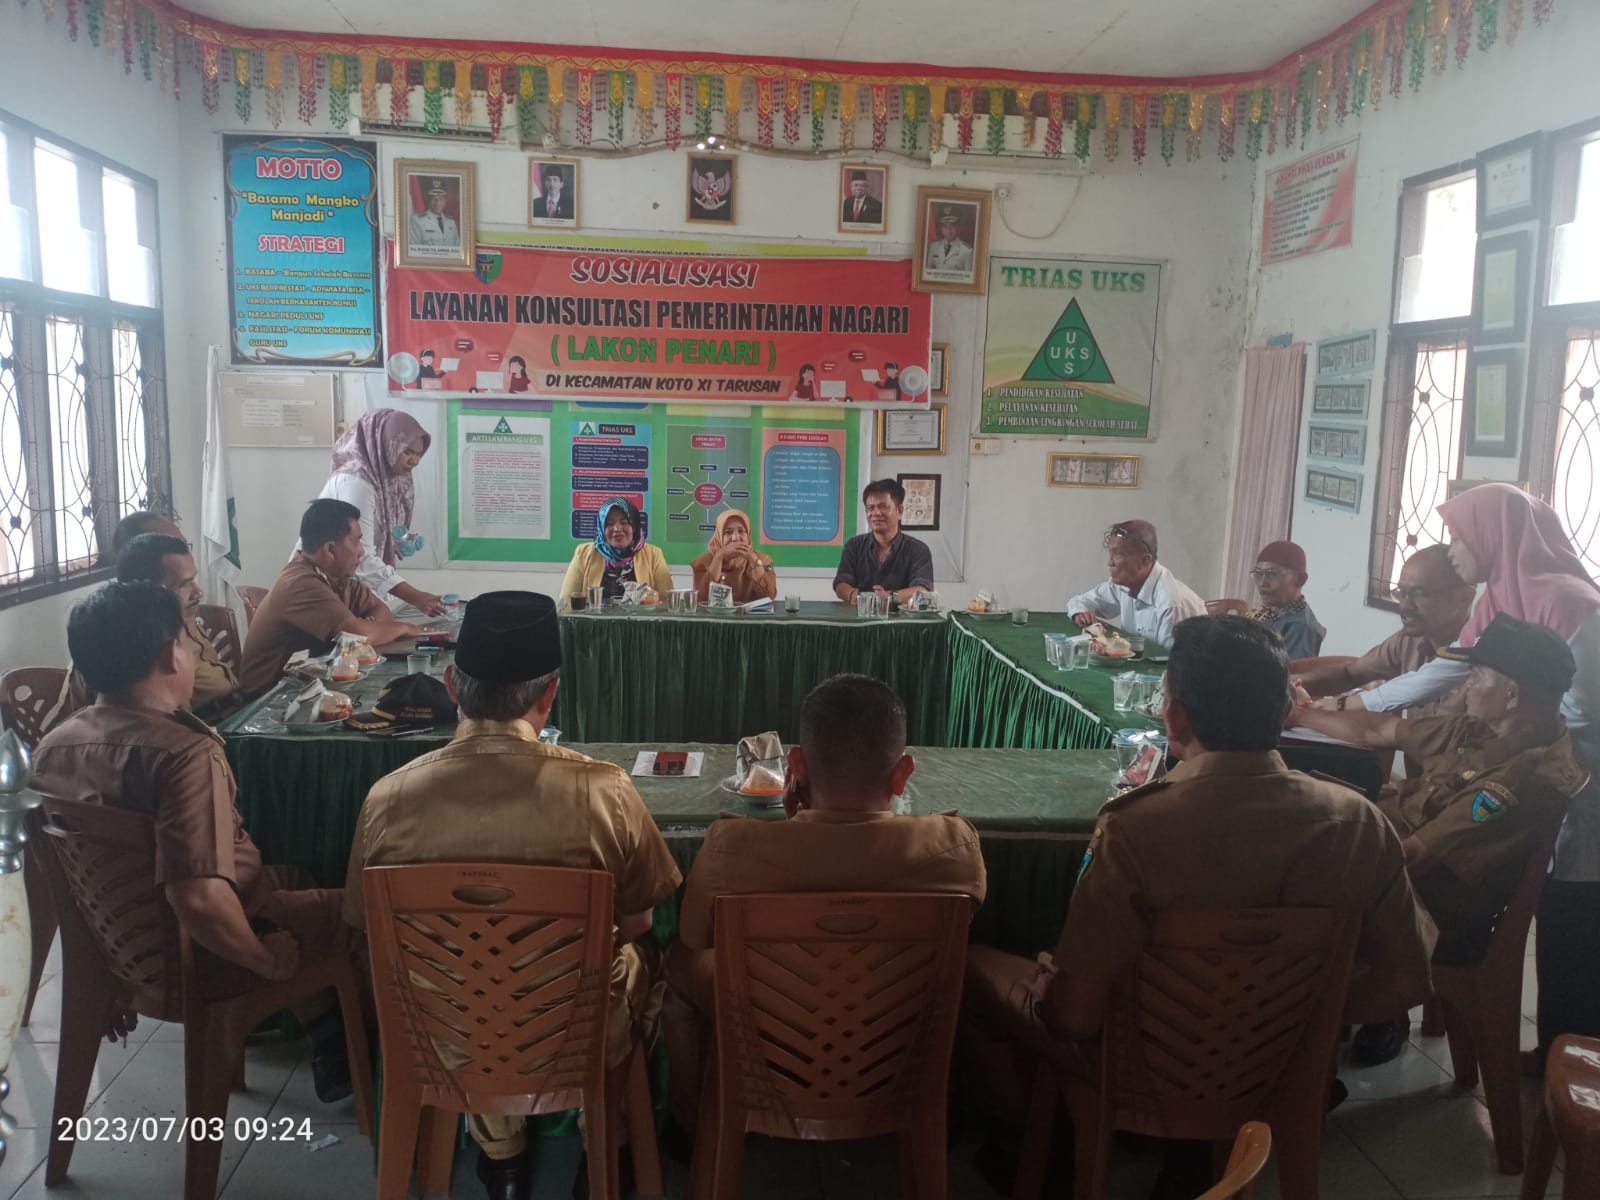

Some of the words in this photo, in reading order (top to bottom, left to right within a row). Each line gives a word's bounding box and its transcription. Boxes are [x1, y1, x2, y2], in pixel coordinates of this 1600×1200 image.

[256, 156, 342, 181] MOTTO
[306, 194, 360, 207] Mangko
[271, 210, 325, 222] Manjadi
[258, 234, 345, 254] STRATEGI
[570, 255, 760, 288] SOSIALISASI
[1001, 266, 1083, 289] TRIAS
[1091, 270, 1145, 293] UKS
[410, 291, 509, 323] LAYANAN
[515, 295, 651, 328] KONSULTASI
[656, 300, 823, 333] PEMERINTAHAN
[828, 304, 910, 334] NAGARI
[567, 335, 657, 363] LAKON
[665, 338, 760, 365] PENARI
[546, 374, 561, 387] DI
[565, 374, 652, 390] KECAMATAN
[656, 377, 693, 391] KOTO
[699, 379, 712, 391] XI
[717, 379, 781, 393] TARUSAN
[999, 387, 1044, 398] PENDIDIKAN
[1045, 388, 1084, 399] KESEHATAN
[999, 402, 1039, 412] PELAYANAN
[1040, 402, 1078, 413] KESEHATAN
